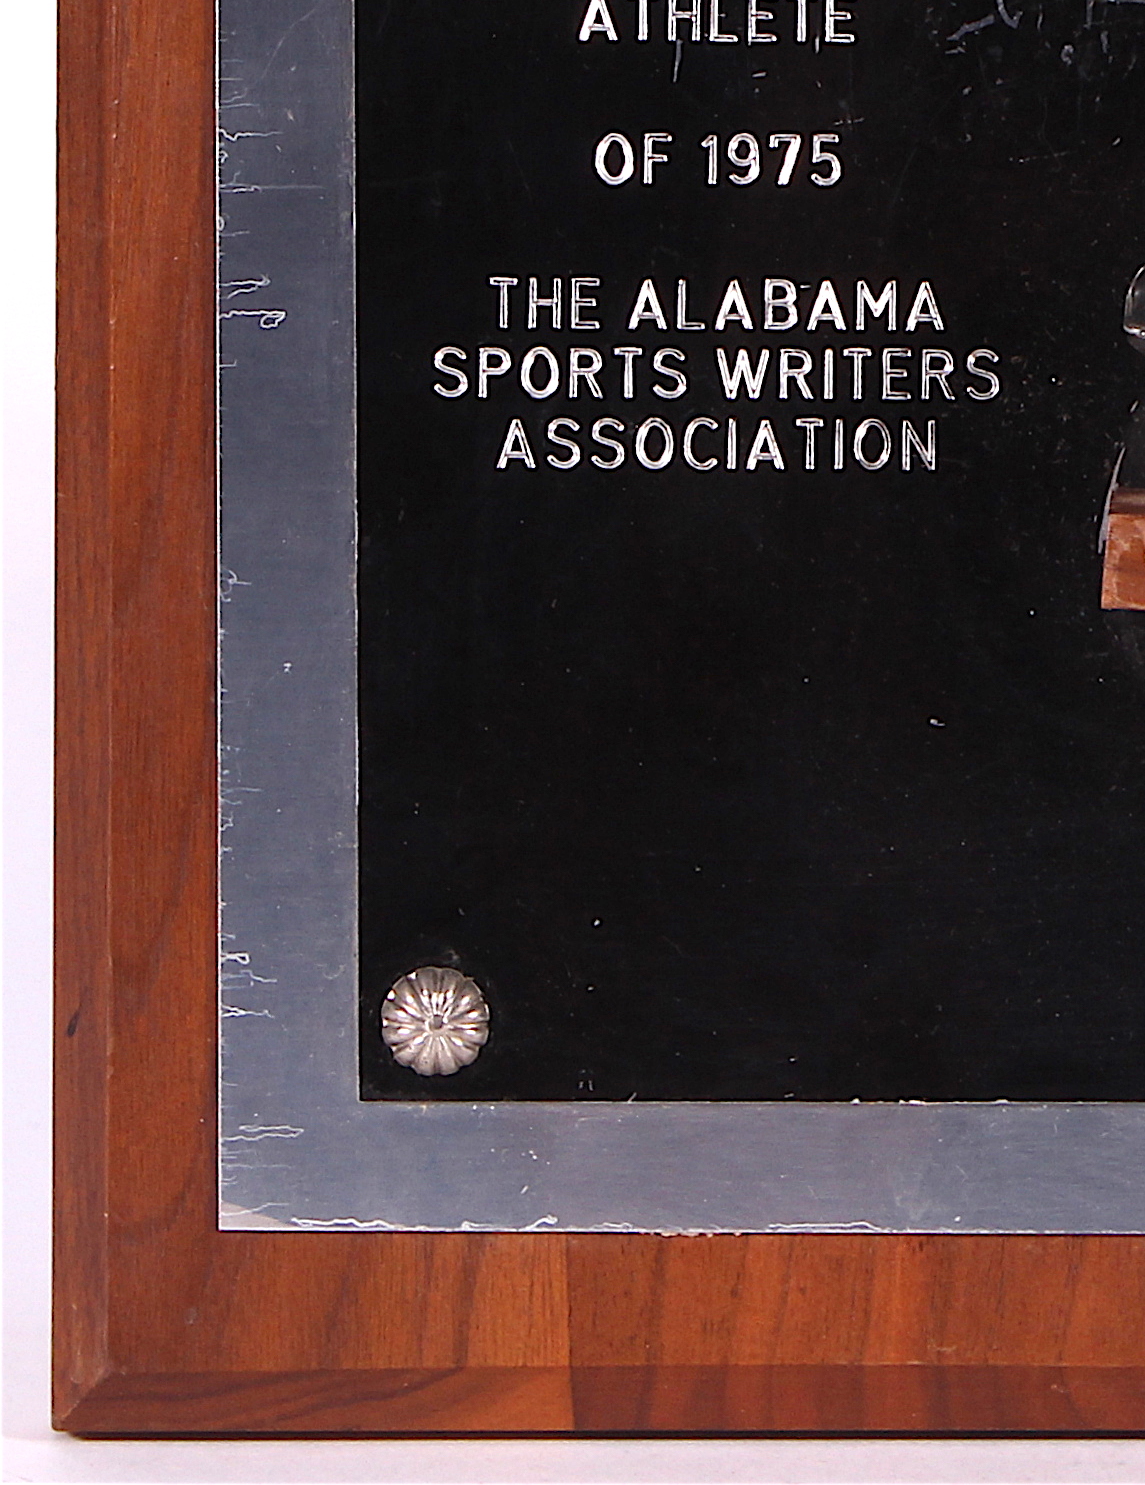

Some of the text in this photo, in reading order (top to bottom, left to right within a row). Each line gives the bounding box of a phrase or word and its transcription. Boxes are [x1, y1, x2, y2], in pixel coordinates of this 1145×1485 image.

[595, 132, 843, 186] OF 1975
[489, 276, 944, 332] THE ALABAMA
[433, 346, 1001, 401] SPORTS WRITERS
[496, 416, 937, 471] ASSOCIATION
